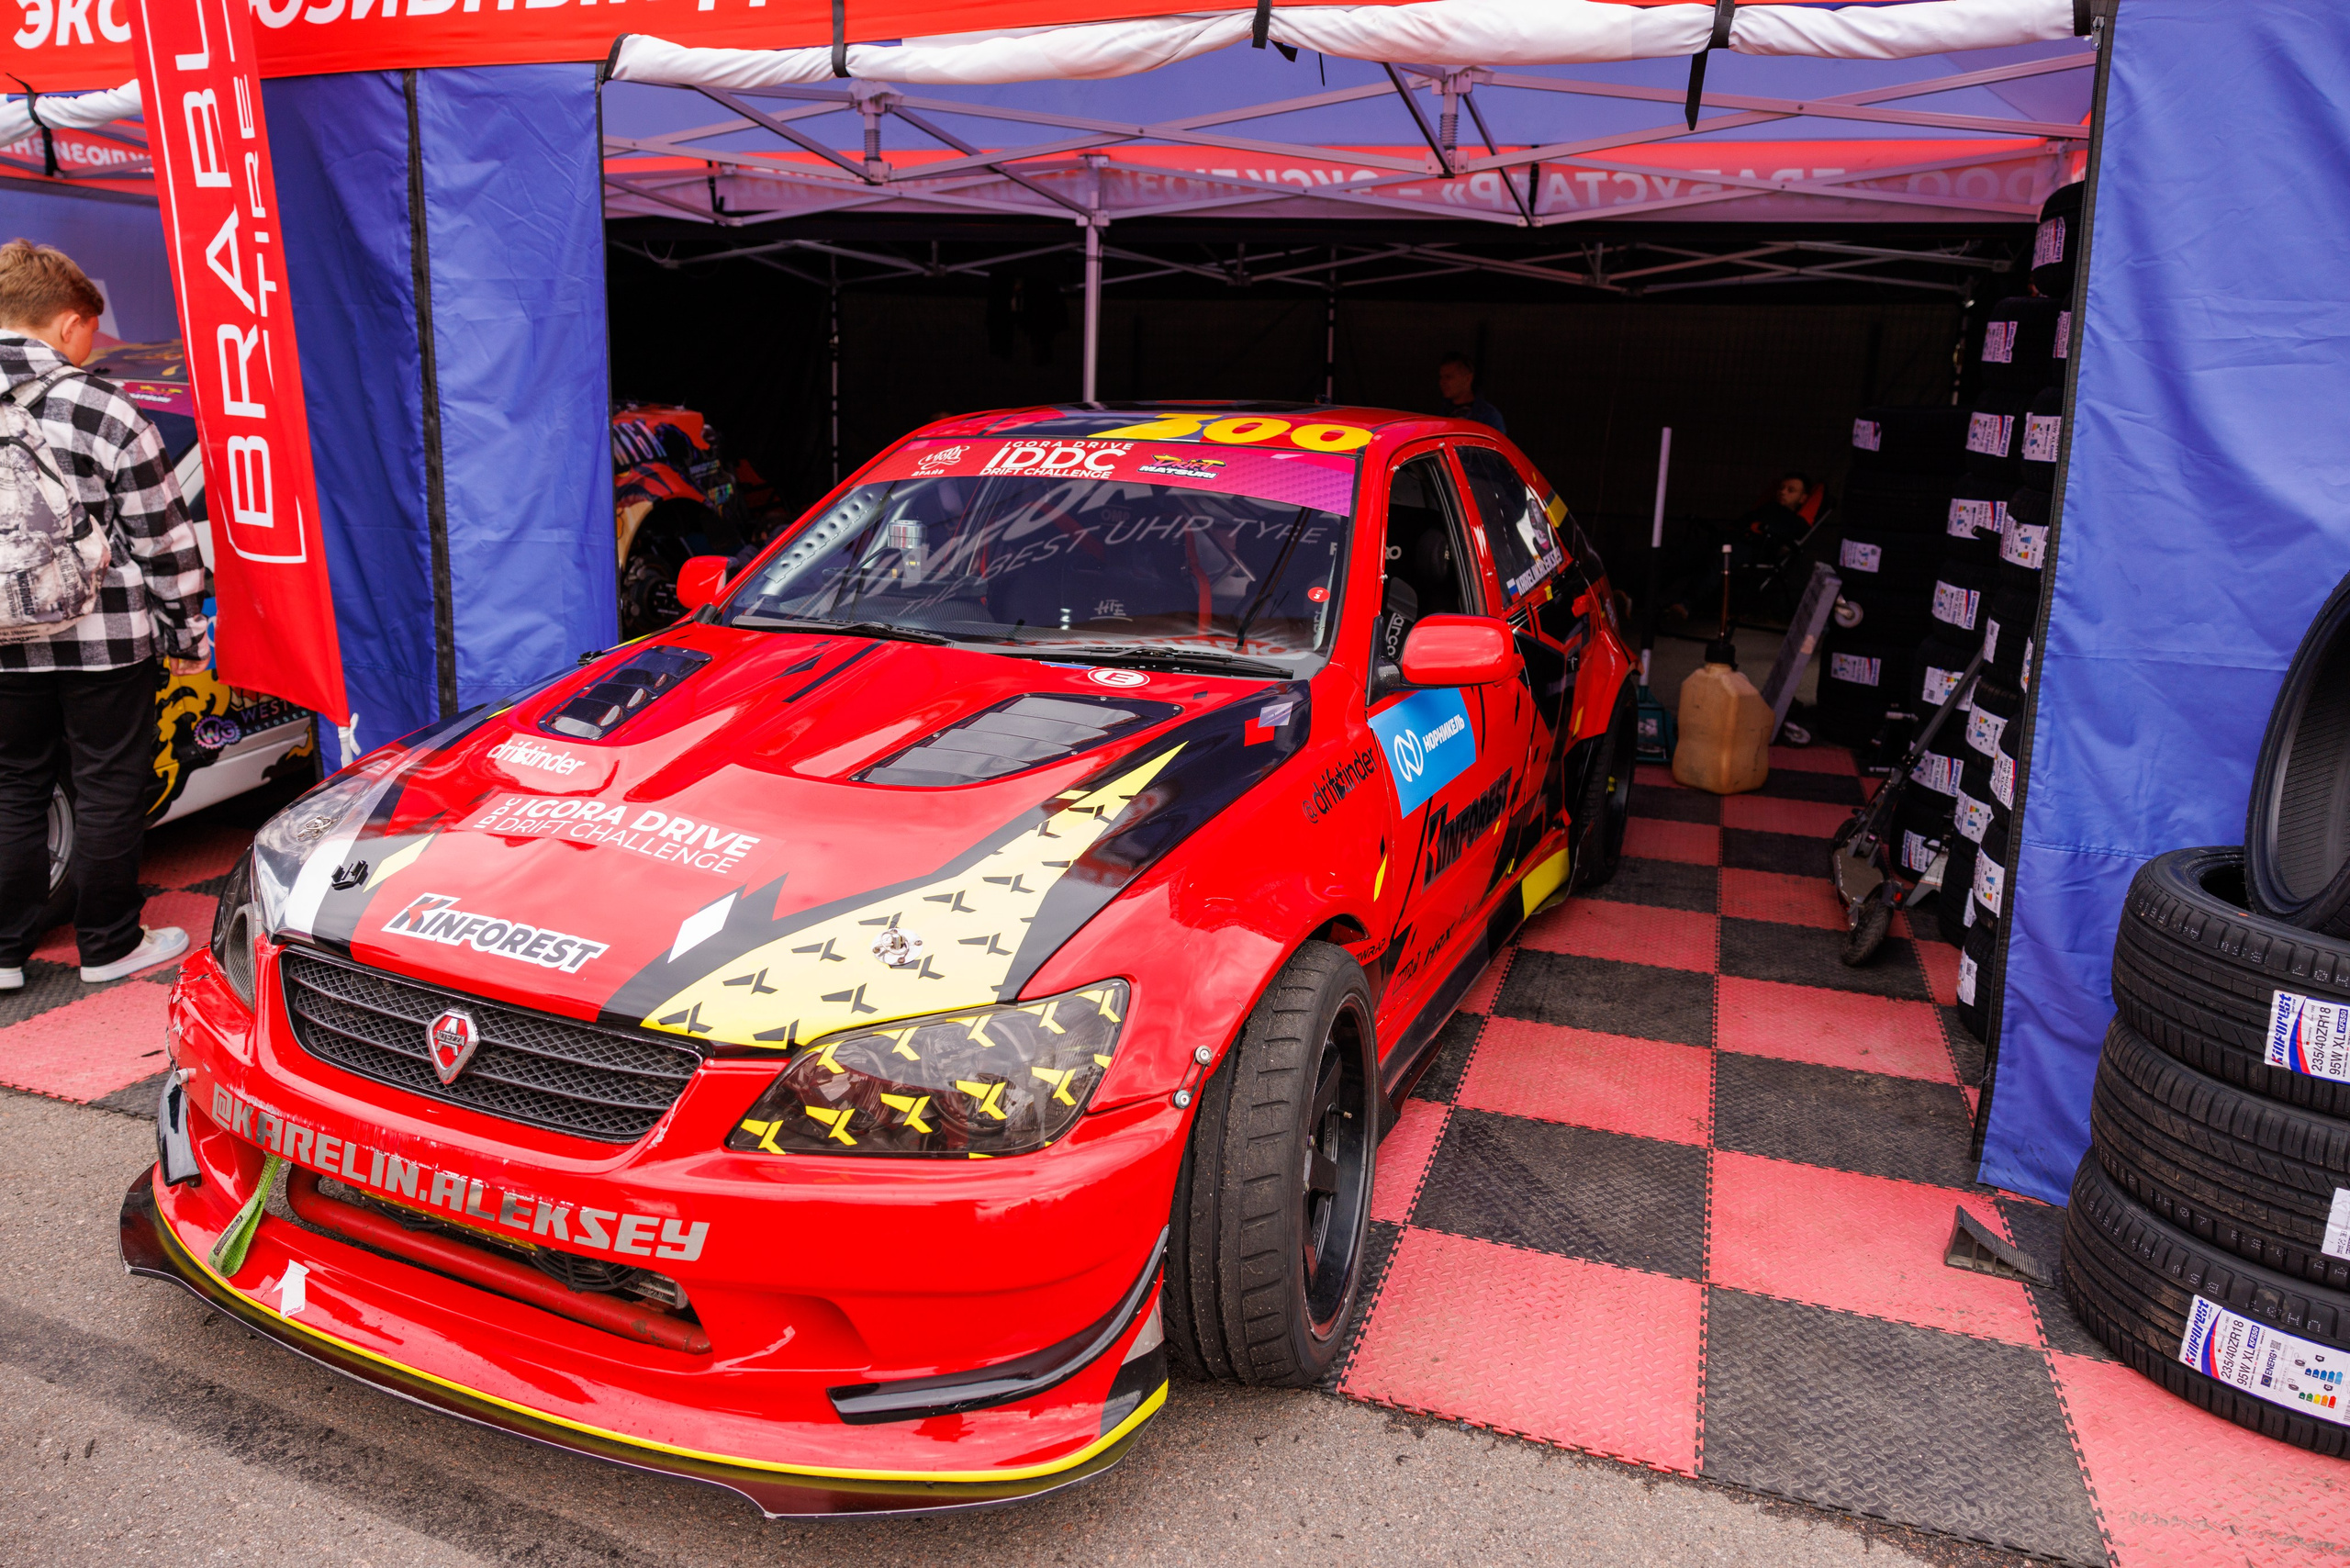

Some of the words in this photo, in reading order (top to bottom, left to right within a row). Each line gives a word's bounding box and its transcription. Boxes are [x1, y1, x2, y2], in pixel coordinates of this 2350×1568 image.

[233, 74, 278, 318] TIRE
[1004, 441, 1062, 449] IGORA
[1073, 442, 1135, 451] DRIVE
[985, 447, 1127, 471] IDDC
[979, 467, 1023, 476] DRIFT
[1024, 468, 1113, 479] CHALLENGE
[972, 524, 1101, 588] BEST
[1103, 515, 1215, 545] UHP
[241, 699, 303, 724] WEST
[1422, 713, 1466, 754] НОРНИКЕЛЬ
[512, 799, 628, 826] IGORA
[630, 810, 761, 858] DRIVE
[1422, 766, 1513, 894] KINFOREST
[493, 816, 574, 835] DRIFT
[568, 822, 740, 874] CHALLENGE
[386, 895, 604, 970] KINFOREST
[2337, 1010, 2347, 1032] KF550
[434, 1029, 466, 1047] ALTEZZA
[2311, 1007, 2331, 1071] 235/40ZR18
[2333, 1035, 2345, 1048] XL
[2329, 1051, 2343, 1075] 95W
[211, 1081, 711, 1262] @KARELIN.ALEKSEY
[2221, 1320, 2244, 1379] 235/40ZR18
[2249, 1327, 2258, 1347] KF550
[2242, 1350, 2255, 1362] XL
[2237, 1362, 2251, 1385] 95W
